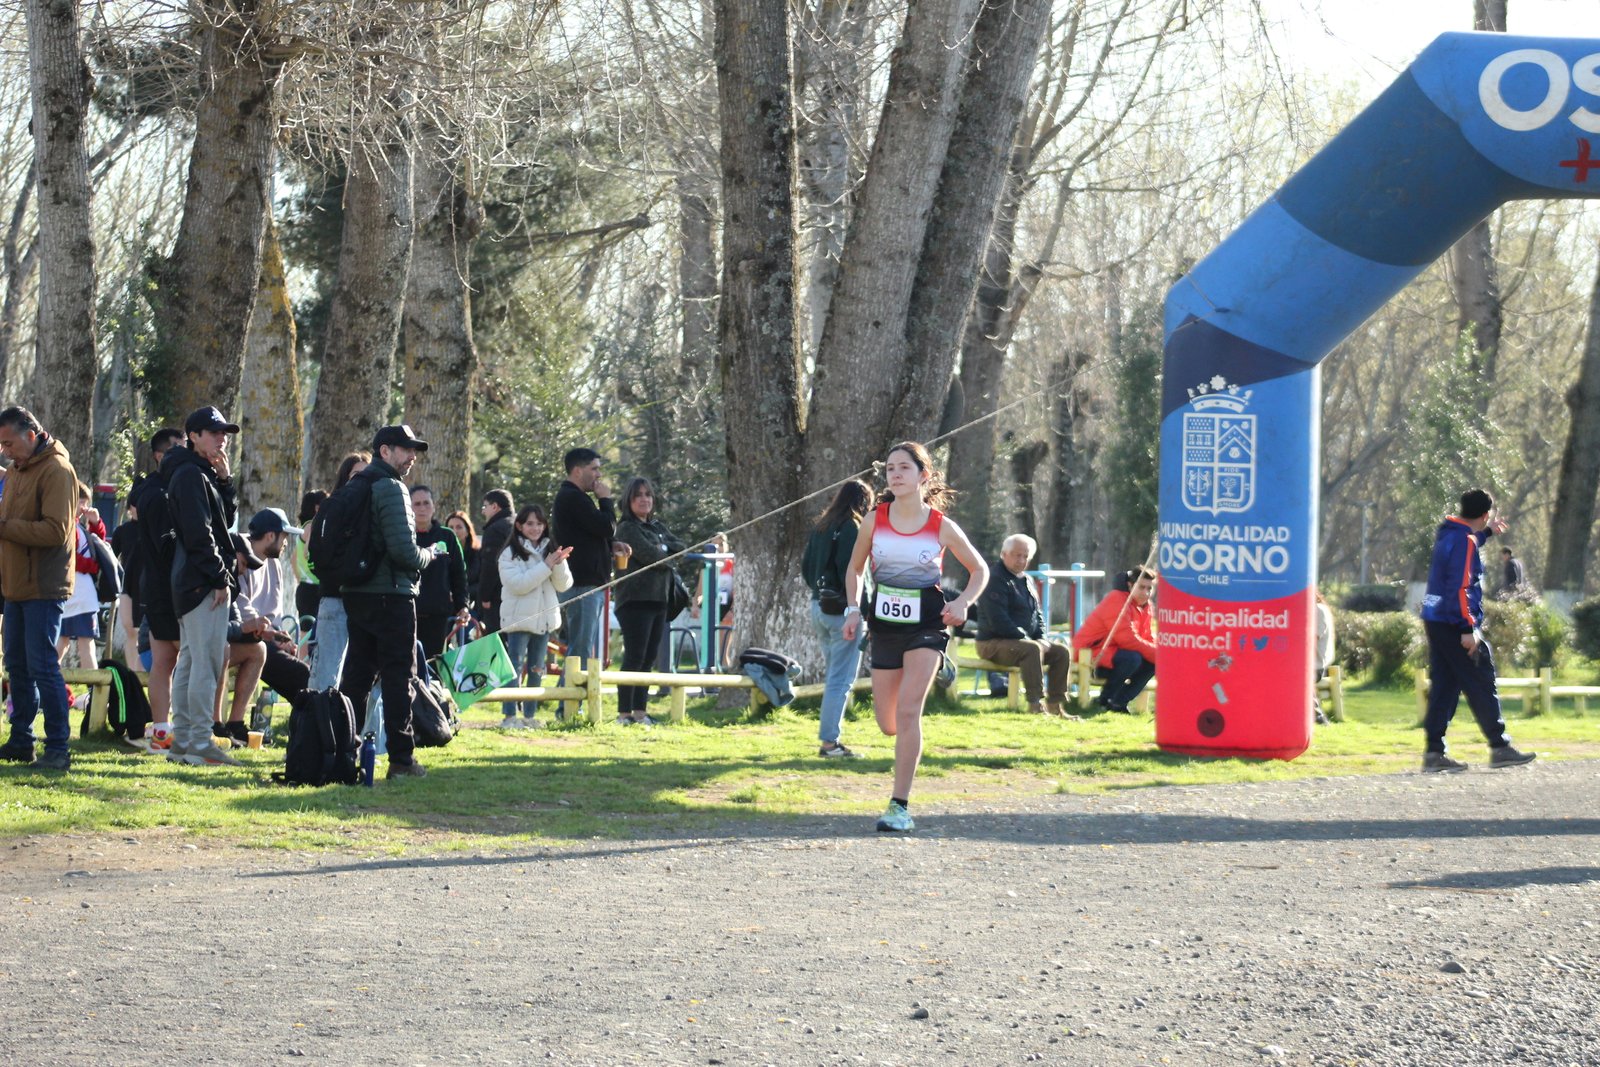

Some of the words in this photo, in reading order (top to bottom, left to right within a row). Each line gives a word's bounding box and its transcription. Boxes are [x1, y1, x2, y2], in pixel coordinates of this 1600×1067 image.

[1160, 522, 1290, 542] MUNICIPALIDAD
[1159, 541, 1289, 574] OSORNO
[1197, 574, 1230, 585] CHILE
[882, 601, 911, 618] 050
[1158, 605, 1289, 631] municipalidad
[1157, 632, 1231, 650] osorno.cl
